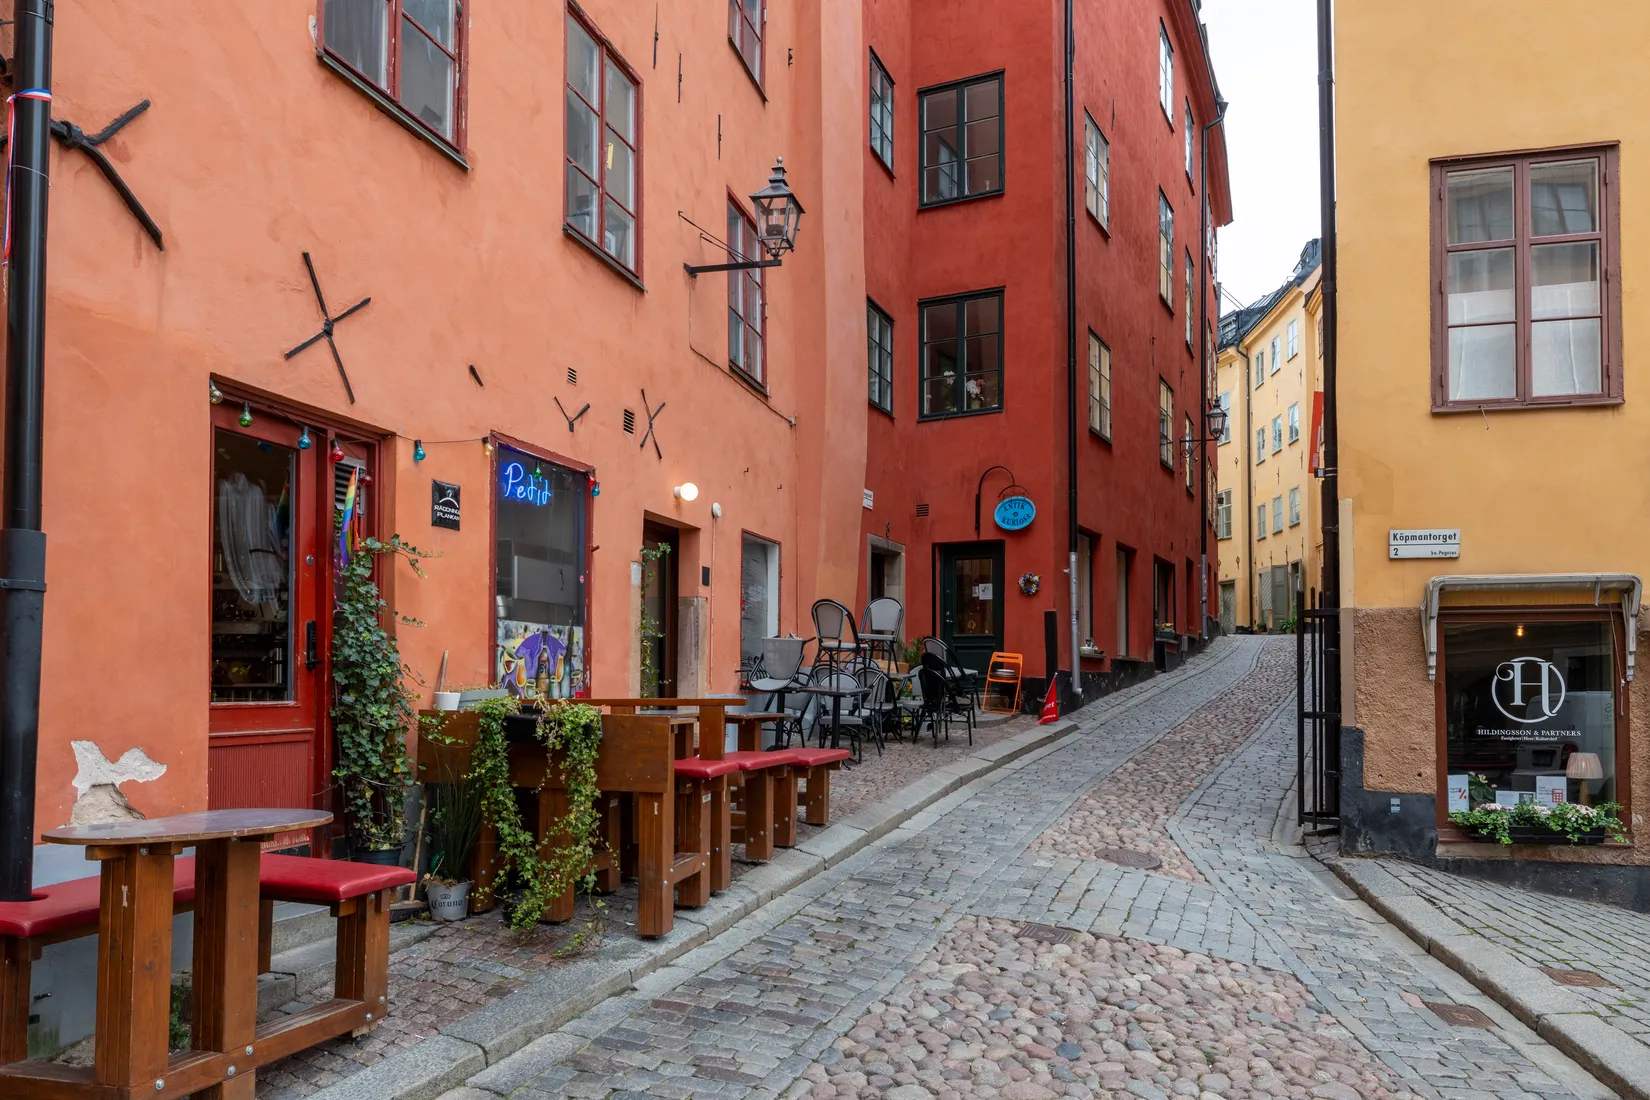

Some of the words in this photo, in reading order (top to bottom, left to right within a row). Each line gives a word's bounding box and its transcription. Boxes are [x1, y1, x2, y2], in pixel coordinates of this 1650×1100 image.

[1003, 501, 1026, 512] ANTIK
[1001, 513, 1032, 526] KURIOSA
[1392, 532, 1457, 543] Köpmantorget
[1393, 547, 1399, 556] 2
[431, 899, 463, 909] Corona
